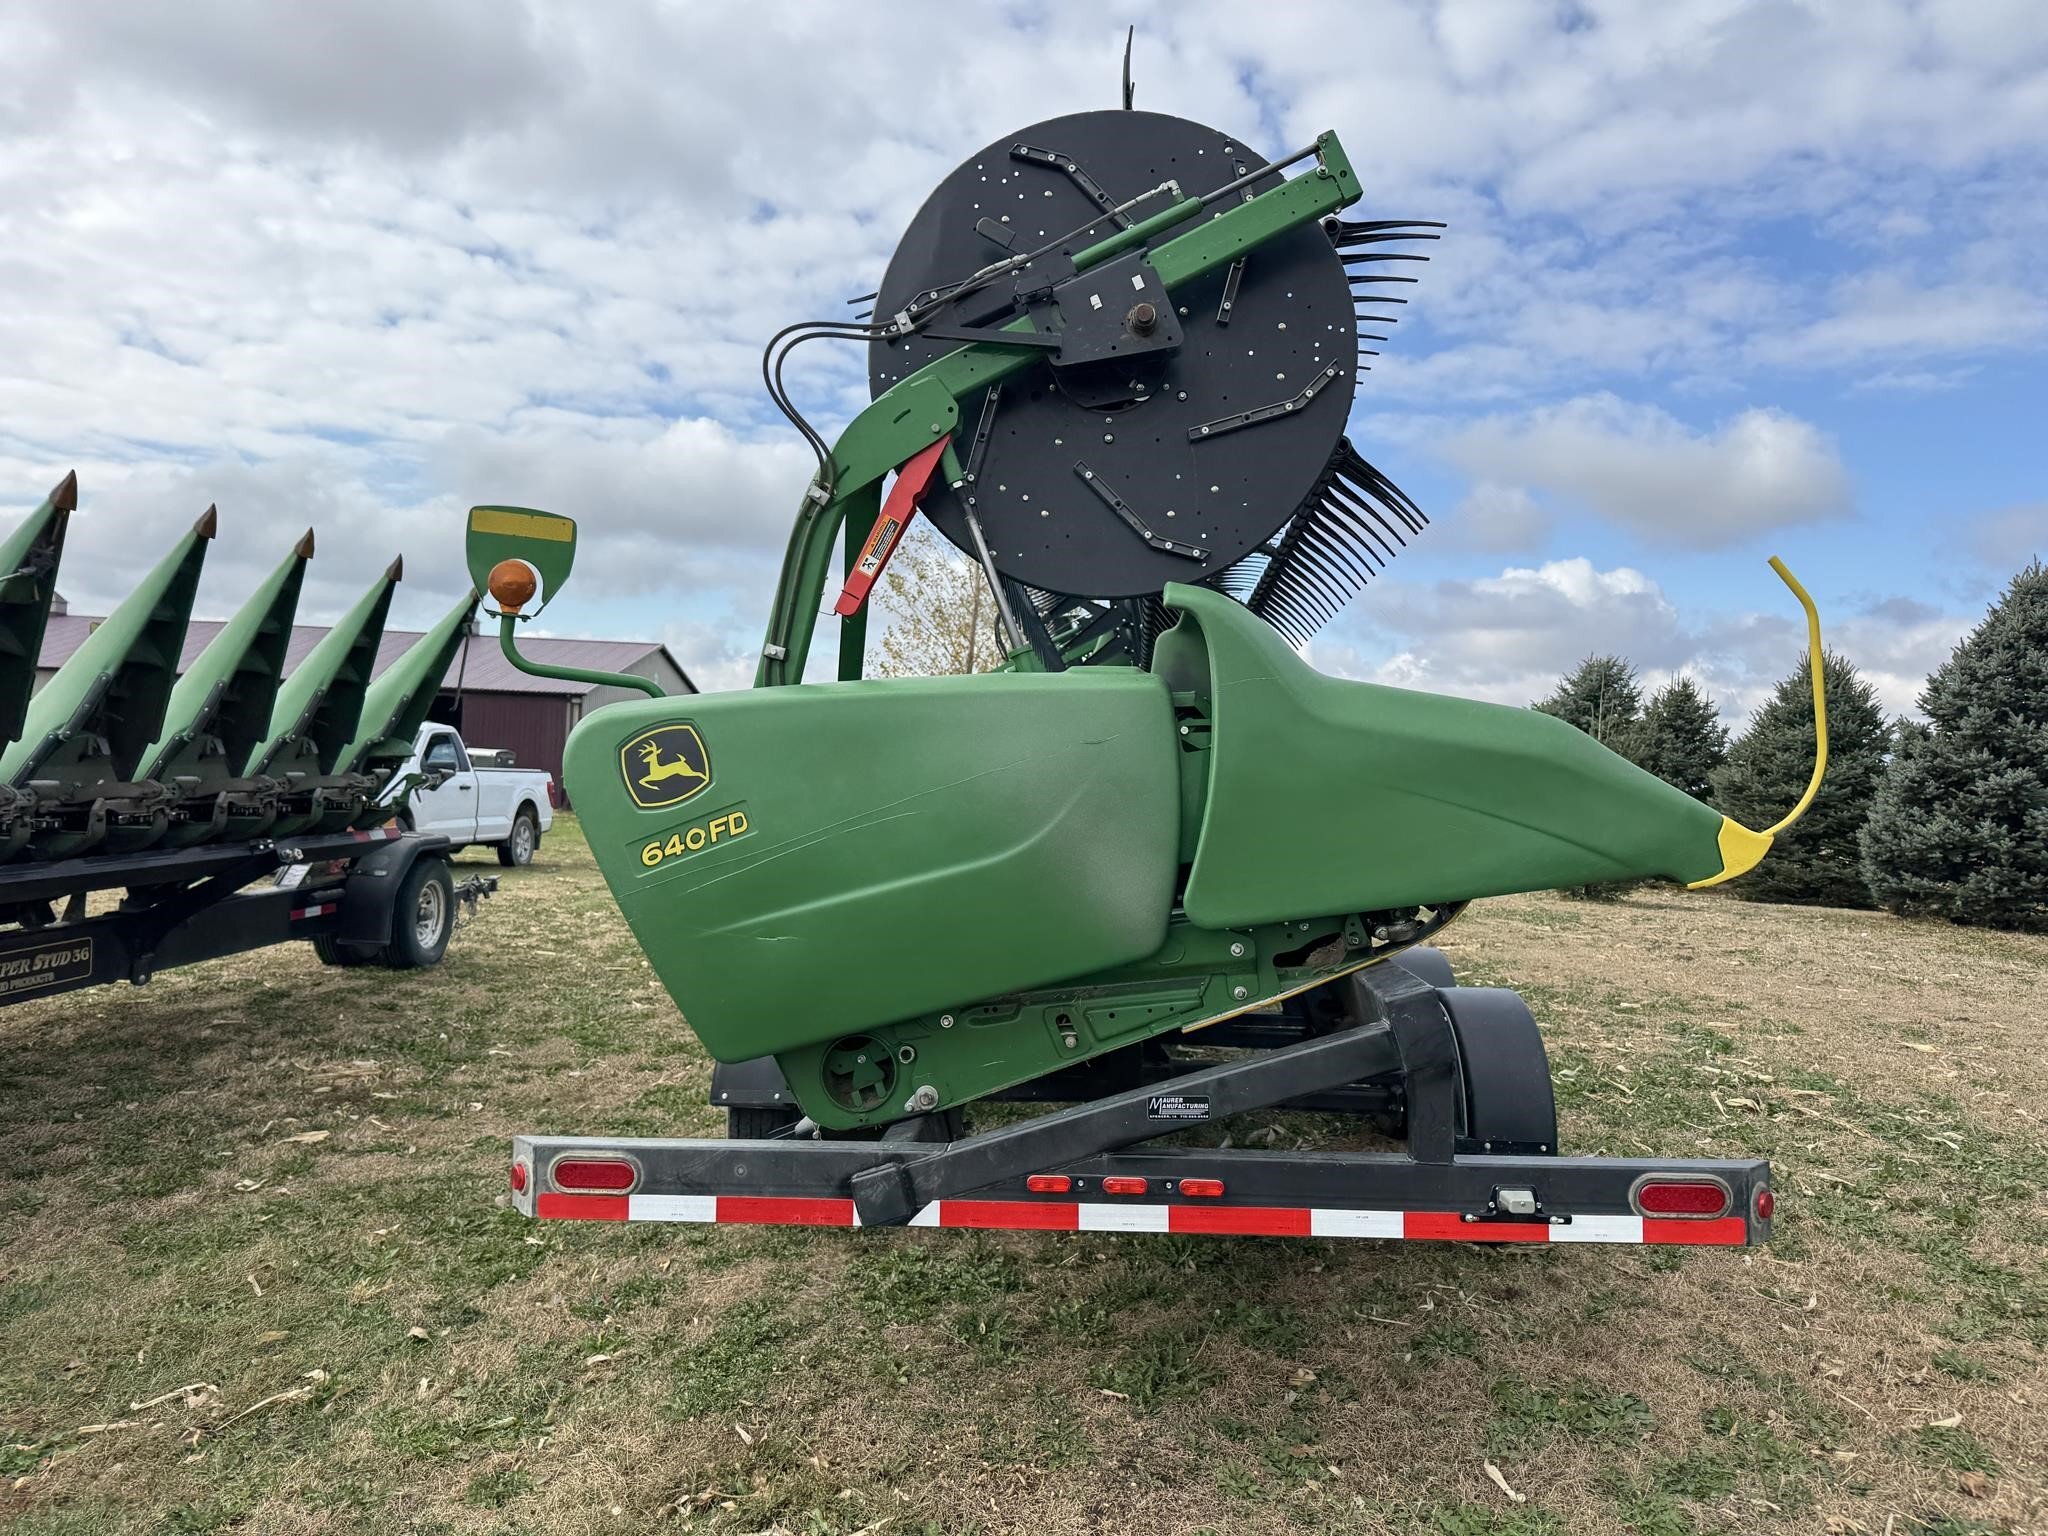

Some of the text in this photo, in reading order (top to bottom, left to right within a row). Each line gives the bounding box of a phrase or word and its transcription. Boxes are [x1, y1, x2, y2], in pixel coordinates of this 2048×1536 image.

[32, 950, 72, 971] STUD
[72, 947, 90, 963] 36
[9, 971, 55, 990] PRODUCTS
